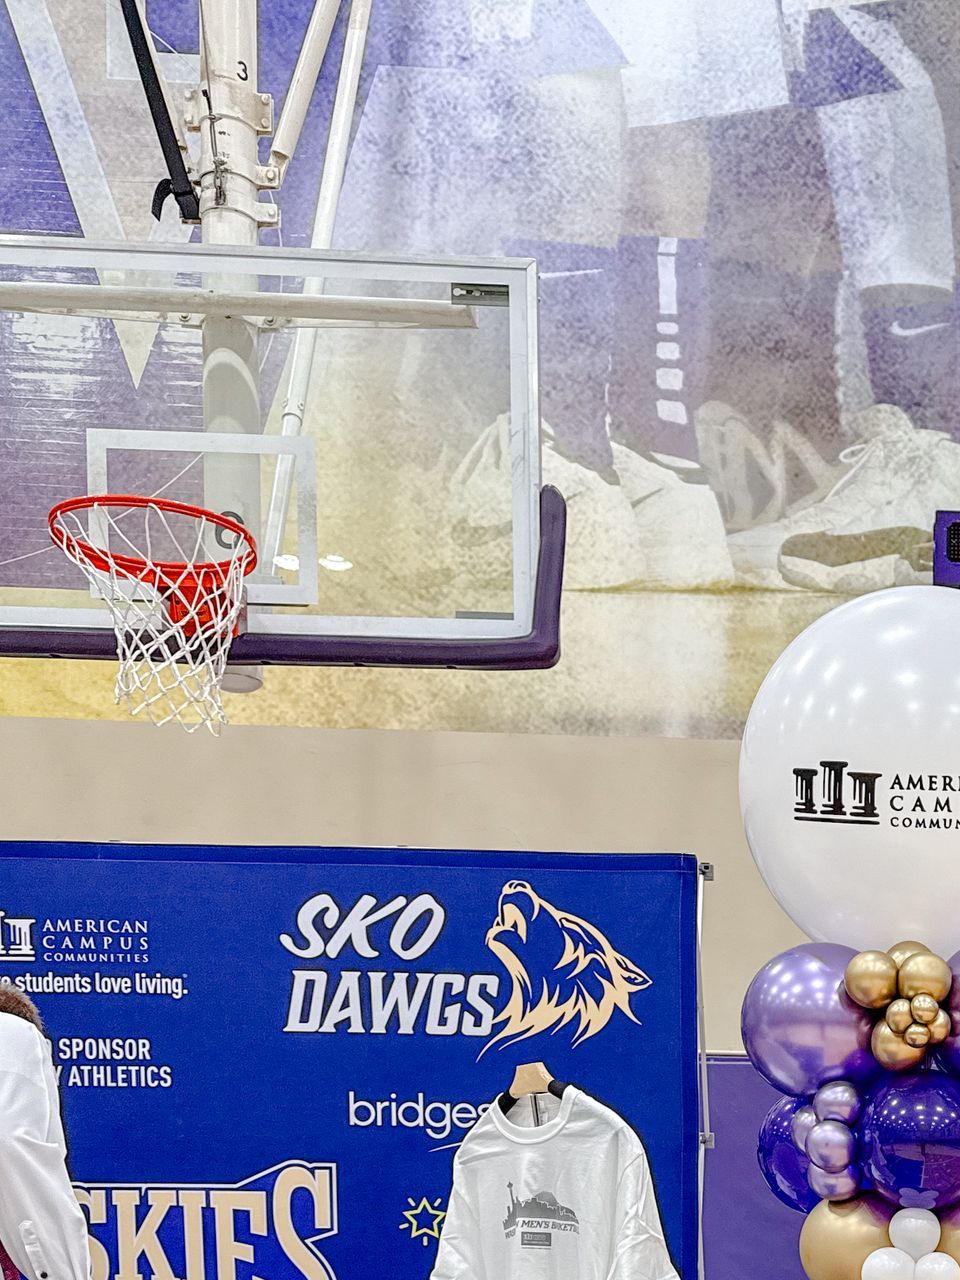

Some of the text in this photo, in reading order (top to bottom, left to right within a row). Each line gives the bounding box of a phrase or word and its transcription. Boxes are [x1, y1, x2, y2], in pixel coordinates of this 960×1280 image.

[42, 918, 149, 934] AMERICAN
[279, 893, 446, 961] SKO
[42, 935, 149, 950] CAMPUS
[43, 952, 149, 963] COMMUNITIES
[15, 972, 91, 993] students
[95, 972, 132, 993] love
[282, 969, 500, 1036] DAWGS
[58, 1038, 151, 1060] SPONSOR
[67, 1065, 172, 1087] ATHLETICS
